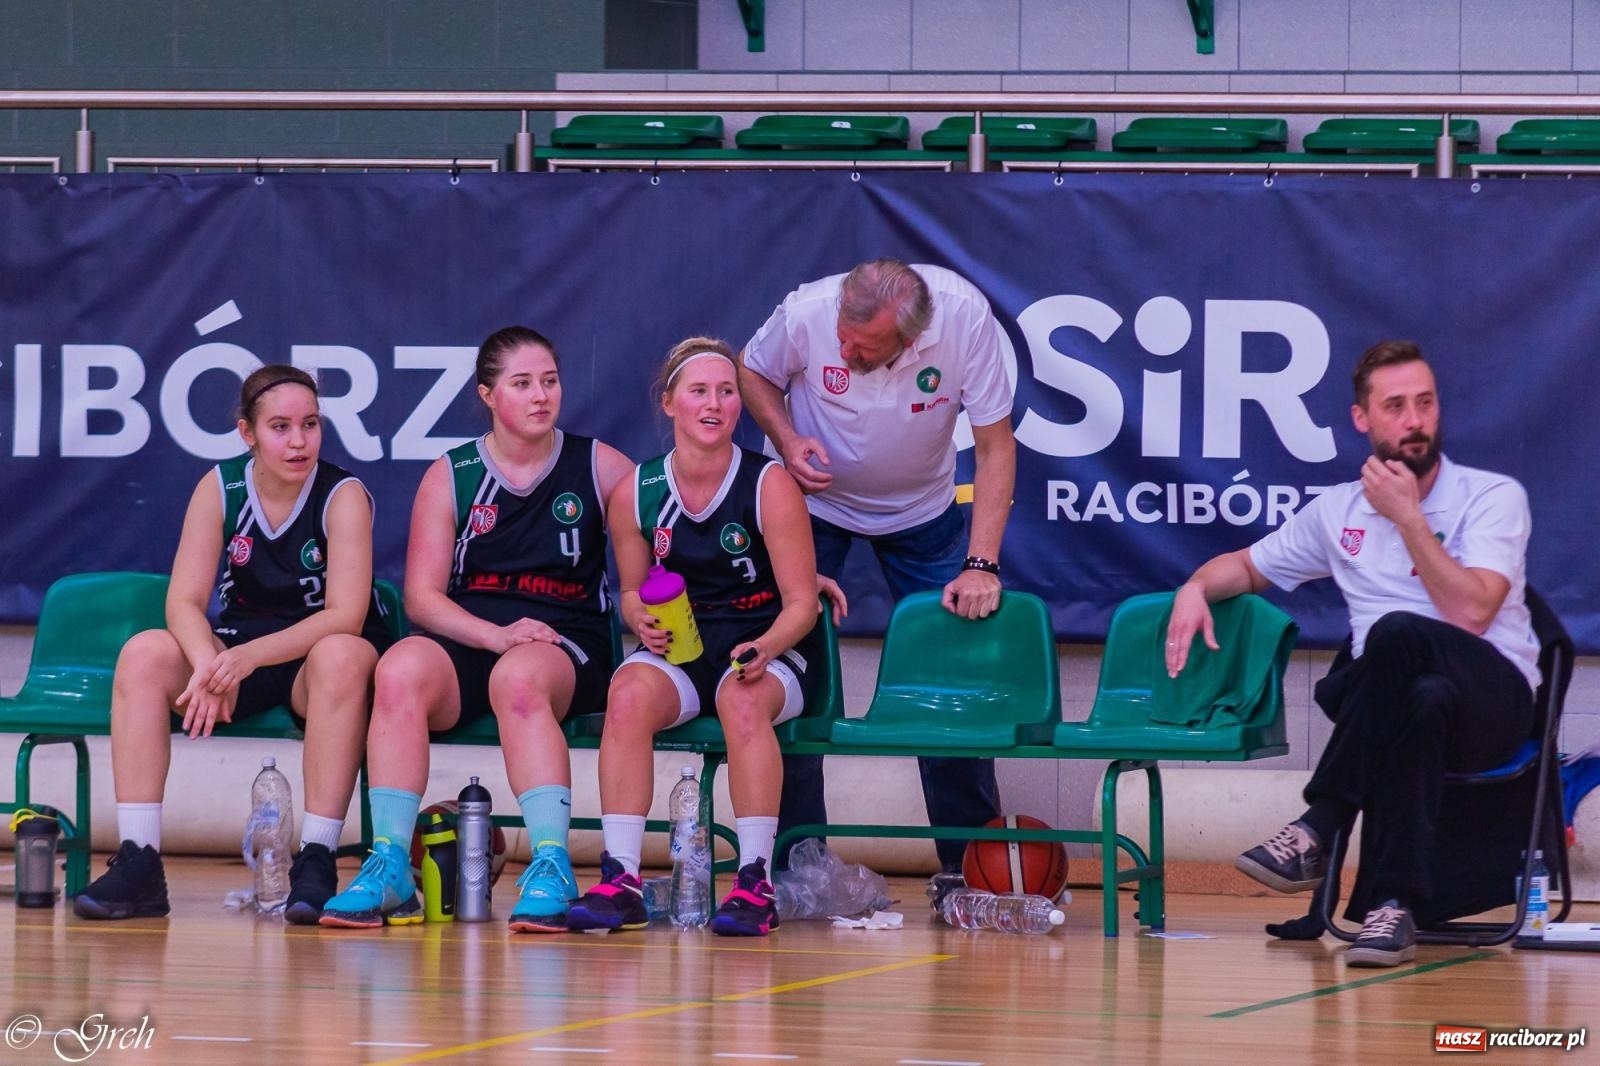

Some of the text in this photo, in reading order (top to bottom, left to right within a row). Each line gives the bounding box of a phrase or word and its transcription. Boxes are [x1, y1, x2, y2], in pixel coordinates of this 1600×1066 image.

[0, 299, 480, 462] IBÓRZ
[954, 294, 1338, 463] SiR
[559, 527, 582, 568] 4
